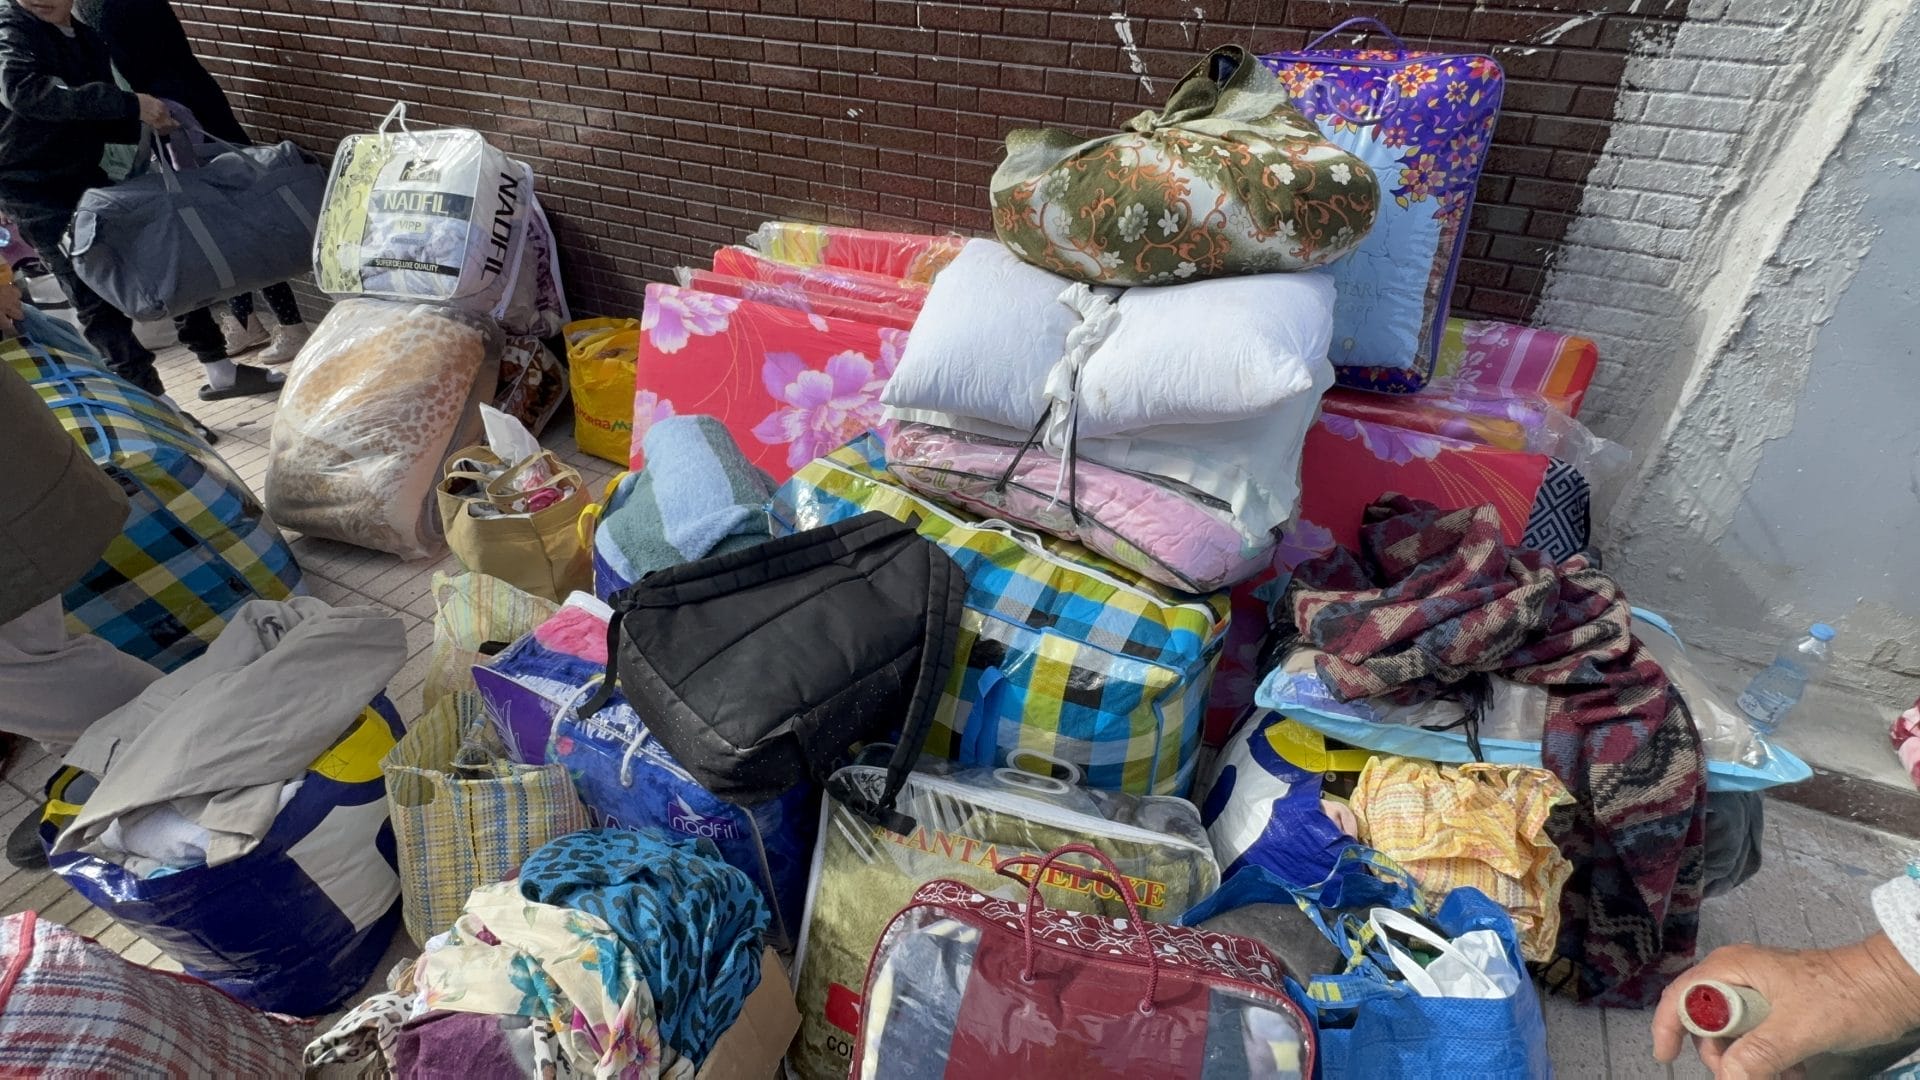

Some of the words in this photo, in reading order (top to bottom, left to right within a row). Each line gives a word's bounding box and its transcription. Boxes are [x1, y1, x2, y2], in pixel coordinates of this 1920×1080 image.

[383, 192, 449, 214] NADFIL
[481, 172, 518, 280] NADFIL
[375, 259, 393, 268] SUPER
[393, 260, 413, 269] DELUXE
[413, 262, 439, 272] QUALITY
[672, 816, 734, 839] nadfil
[1018, 851, 1167, 909] DELUXE
